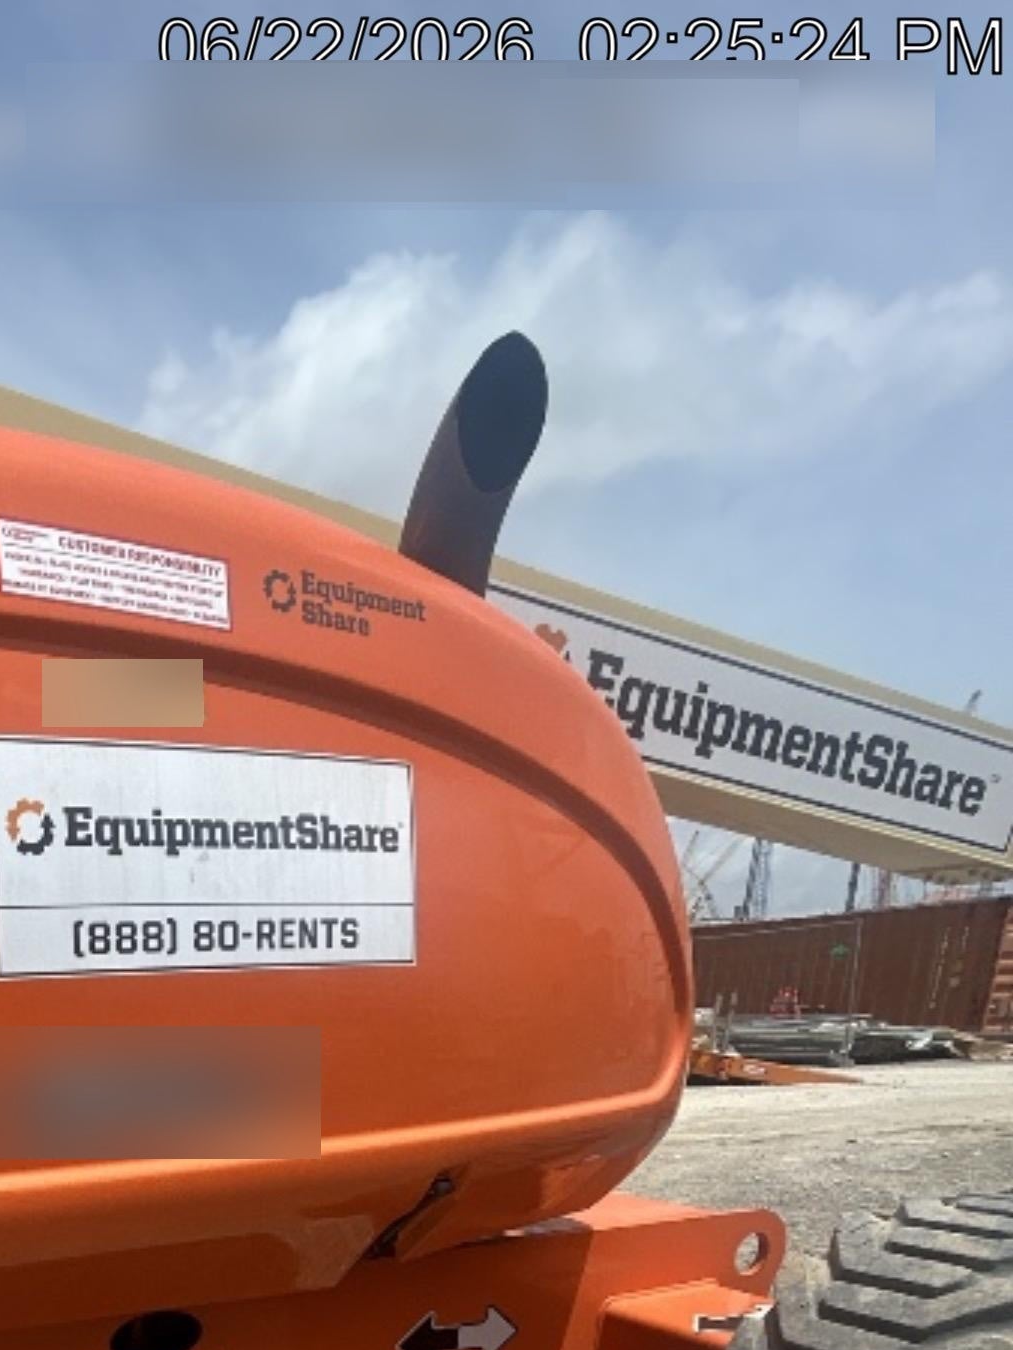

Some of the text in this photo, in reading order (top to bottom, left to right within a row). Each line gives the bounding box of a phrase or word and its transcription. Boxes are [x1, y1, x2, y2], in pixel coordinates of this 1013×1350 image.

[301, 570, 426, 621] Equipment
[301, 600, 371, 636] Share
[588, 648, 987, 816] EquipmentShare
[62, 806, 400, 857] EquipmentShare
[73, 917, 359, 958] (888) 80-RENTS
